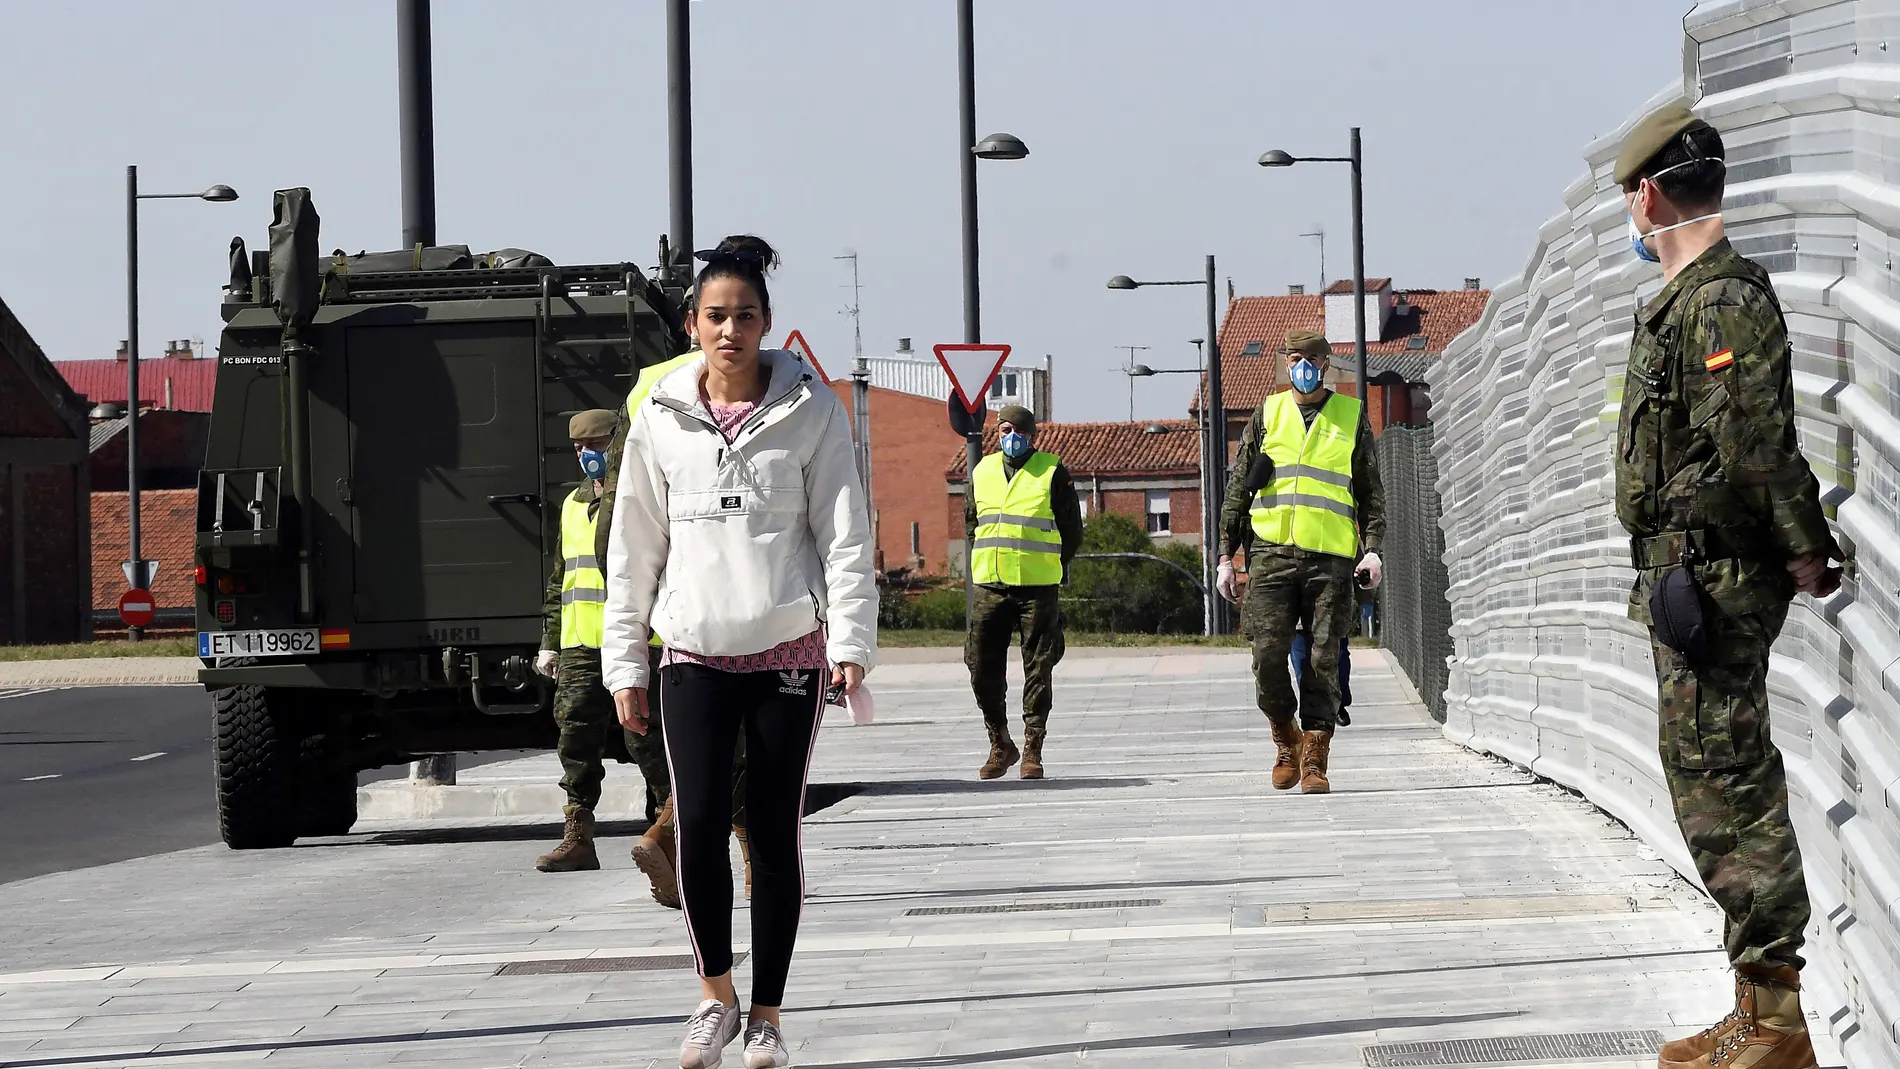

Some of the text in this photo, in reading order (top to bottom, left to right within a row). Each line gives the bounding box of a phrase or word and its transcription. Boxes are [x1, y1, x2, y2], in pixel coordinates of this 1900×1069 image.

[252, 356, 267, 364] FDC
[268, 356, 281, 364] 013
[213, 631, 315, 654] ET 119962
[779, 685, 807, 696] adidas
